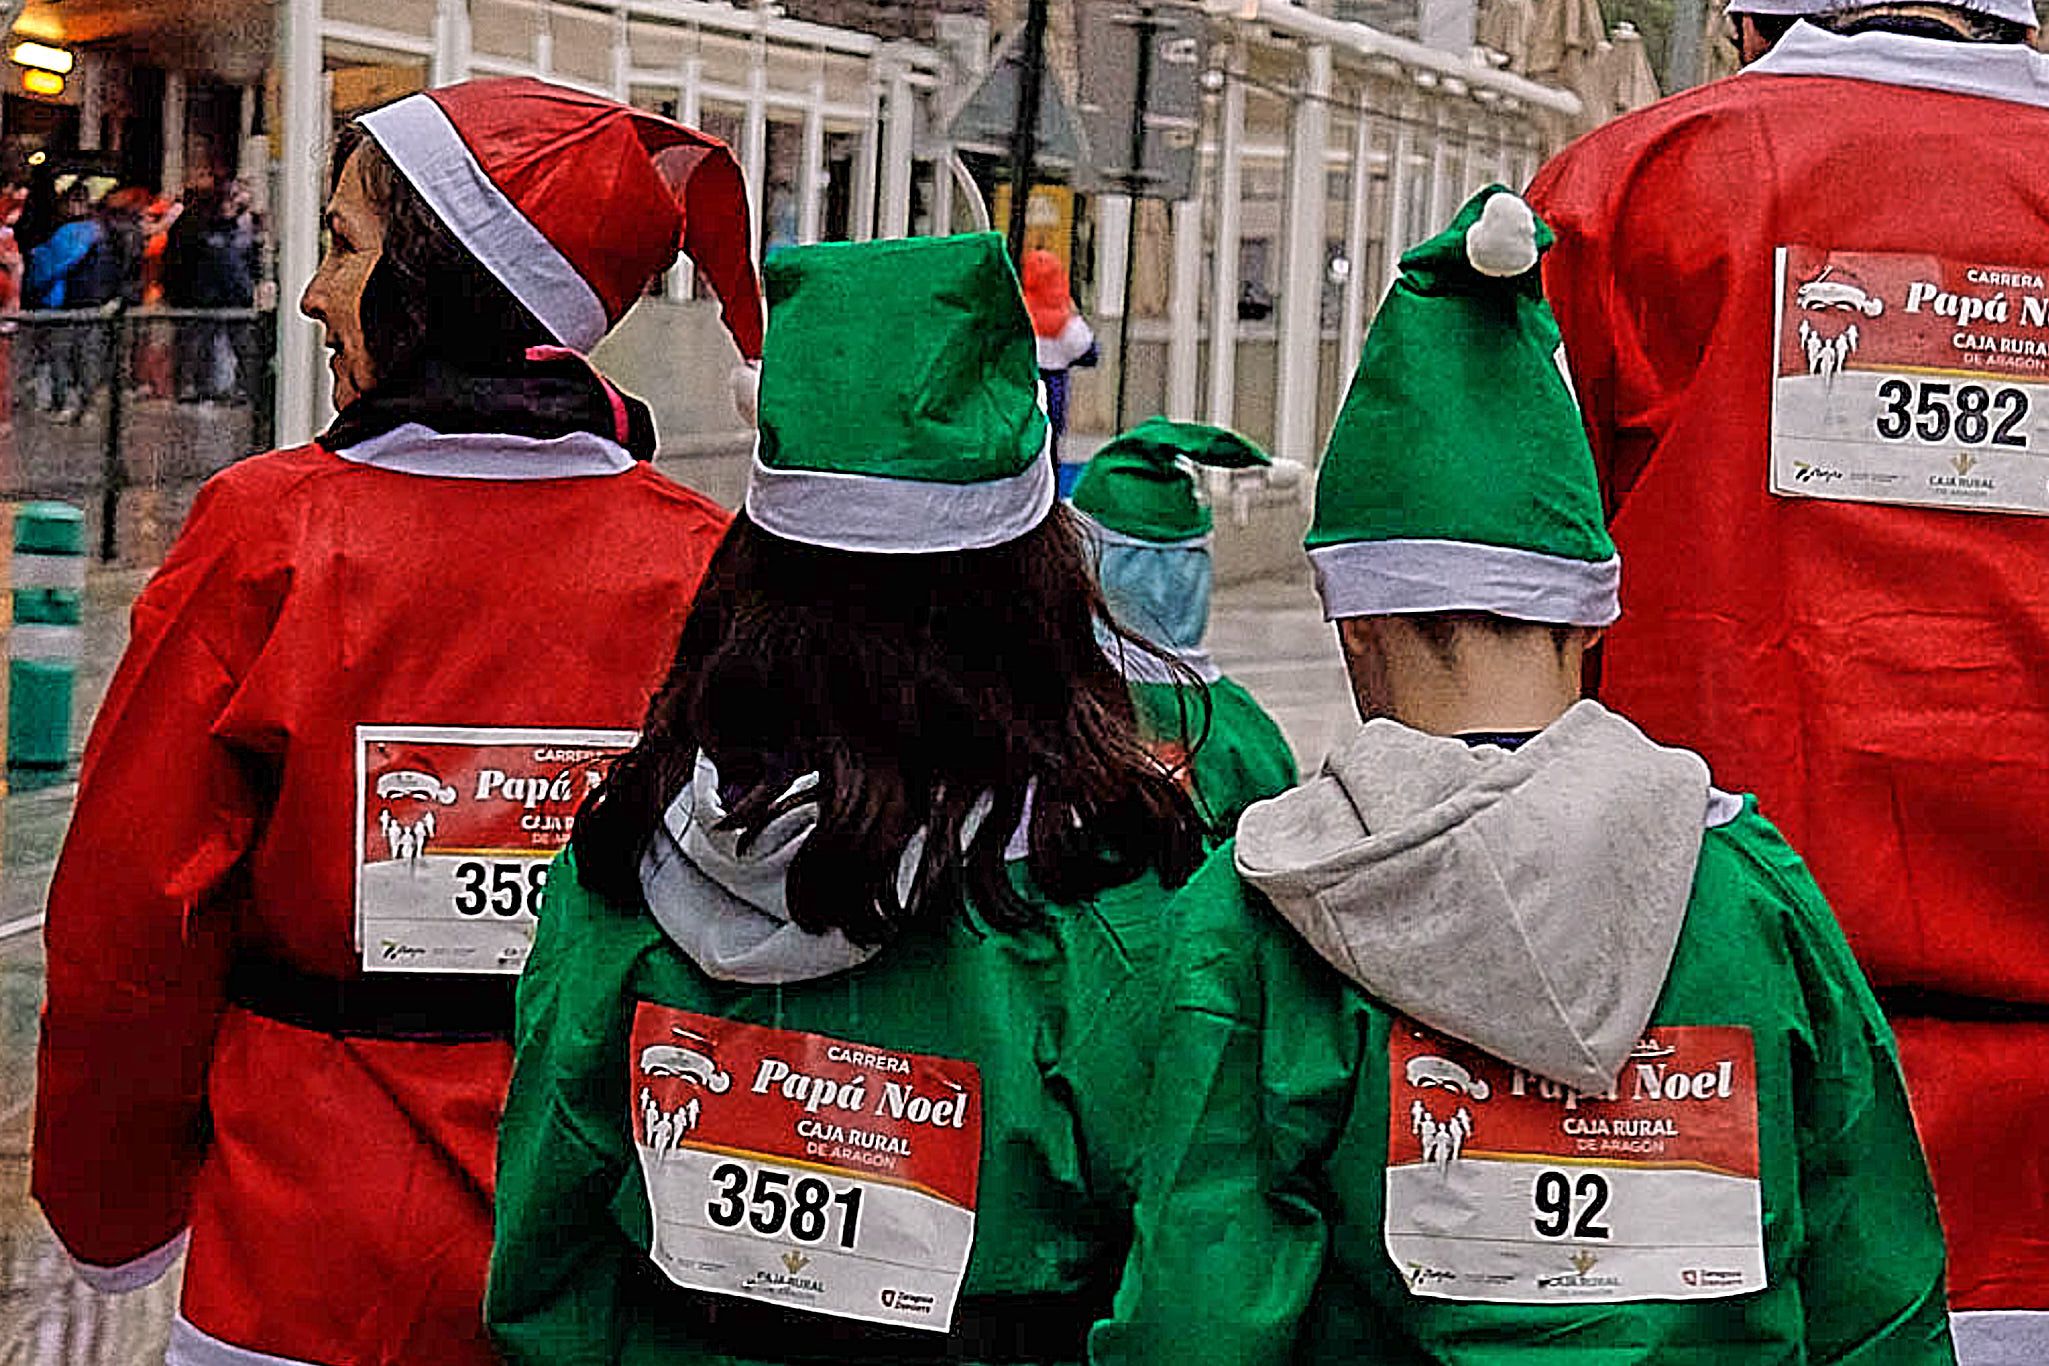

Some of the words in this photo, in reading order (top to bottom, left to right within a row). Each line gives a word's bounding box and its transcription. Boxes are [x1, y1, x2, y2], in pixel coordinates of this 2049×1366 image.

[1967, 269, 2044, 288] CARRERA
[1905, 282, 2008, 326] Papá
[1953, 332, 1997, 352] CAJA
[2000, 337, 2049, 356] RURA
[1876, 379, 2029, 446] 3582
[475, 769, 572, 808] Papá
[455, 863, 549, 917] 358
[827, 1046, 910, 1074] CARRERA
[751, 1058, 866, 1113] Papá
[875, 1081, 968, 1128] Noel
[1633, 1061, 1733, 1100] Noel
[797, 1120, 844, 1143] CAJA
[848, 1128, 912, 1156] RURAL
[1563, 1118, 1609, 1135] CAJA
[1613, 1119, 1678, 1137] RURAL
[807, 1141, 827, 1157] DE
[708, 1164, 863, 1250] 3581
[1534, 1171, 1610, 1239] 92
